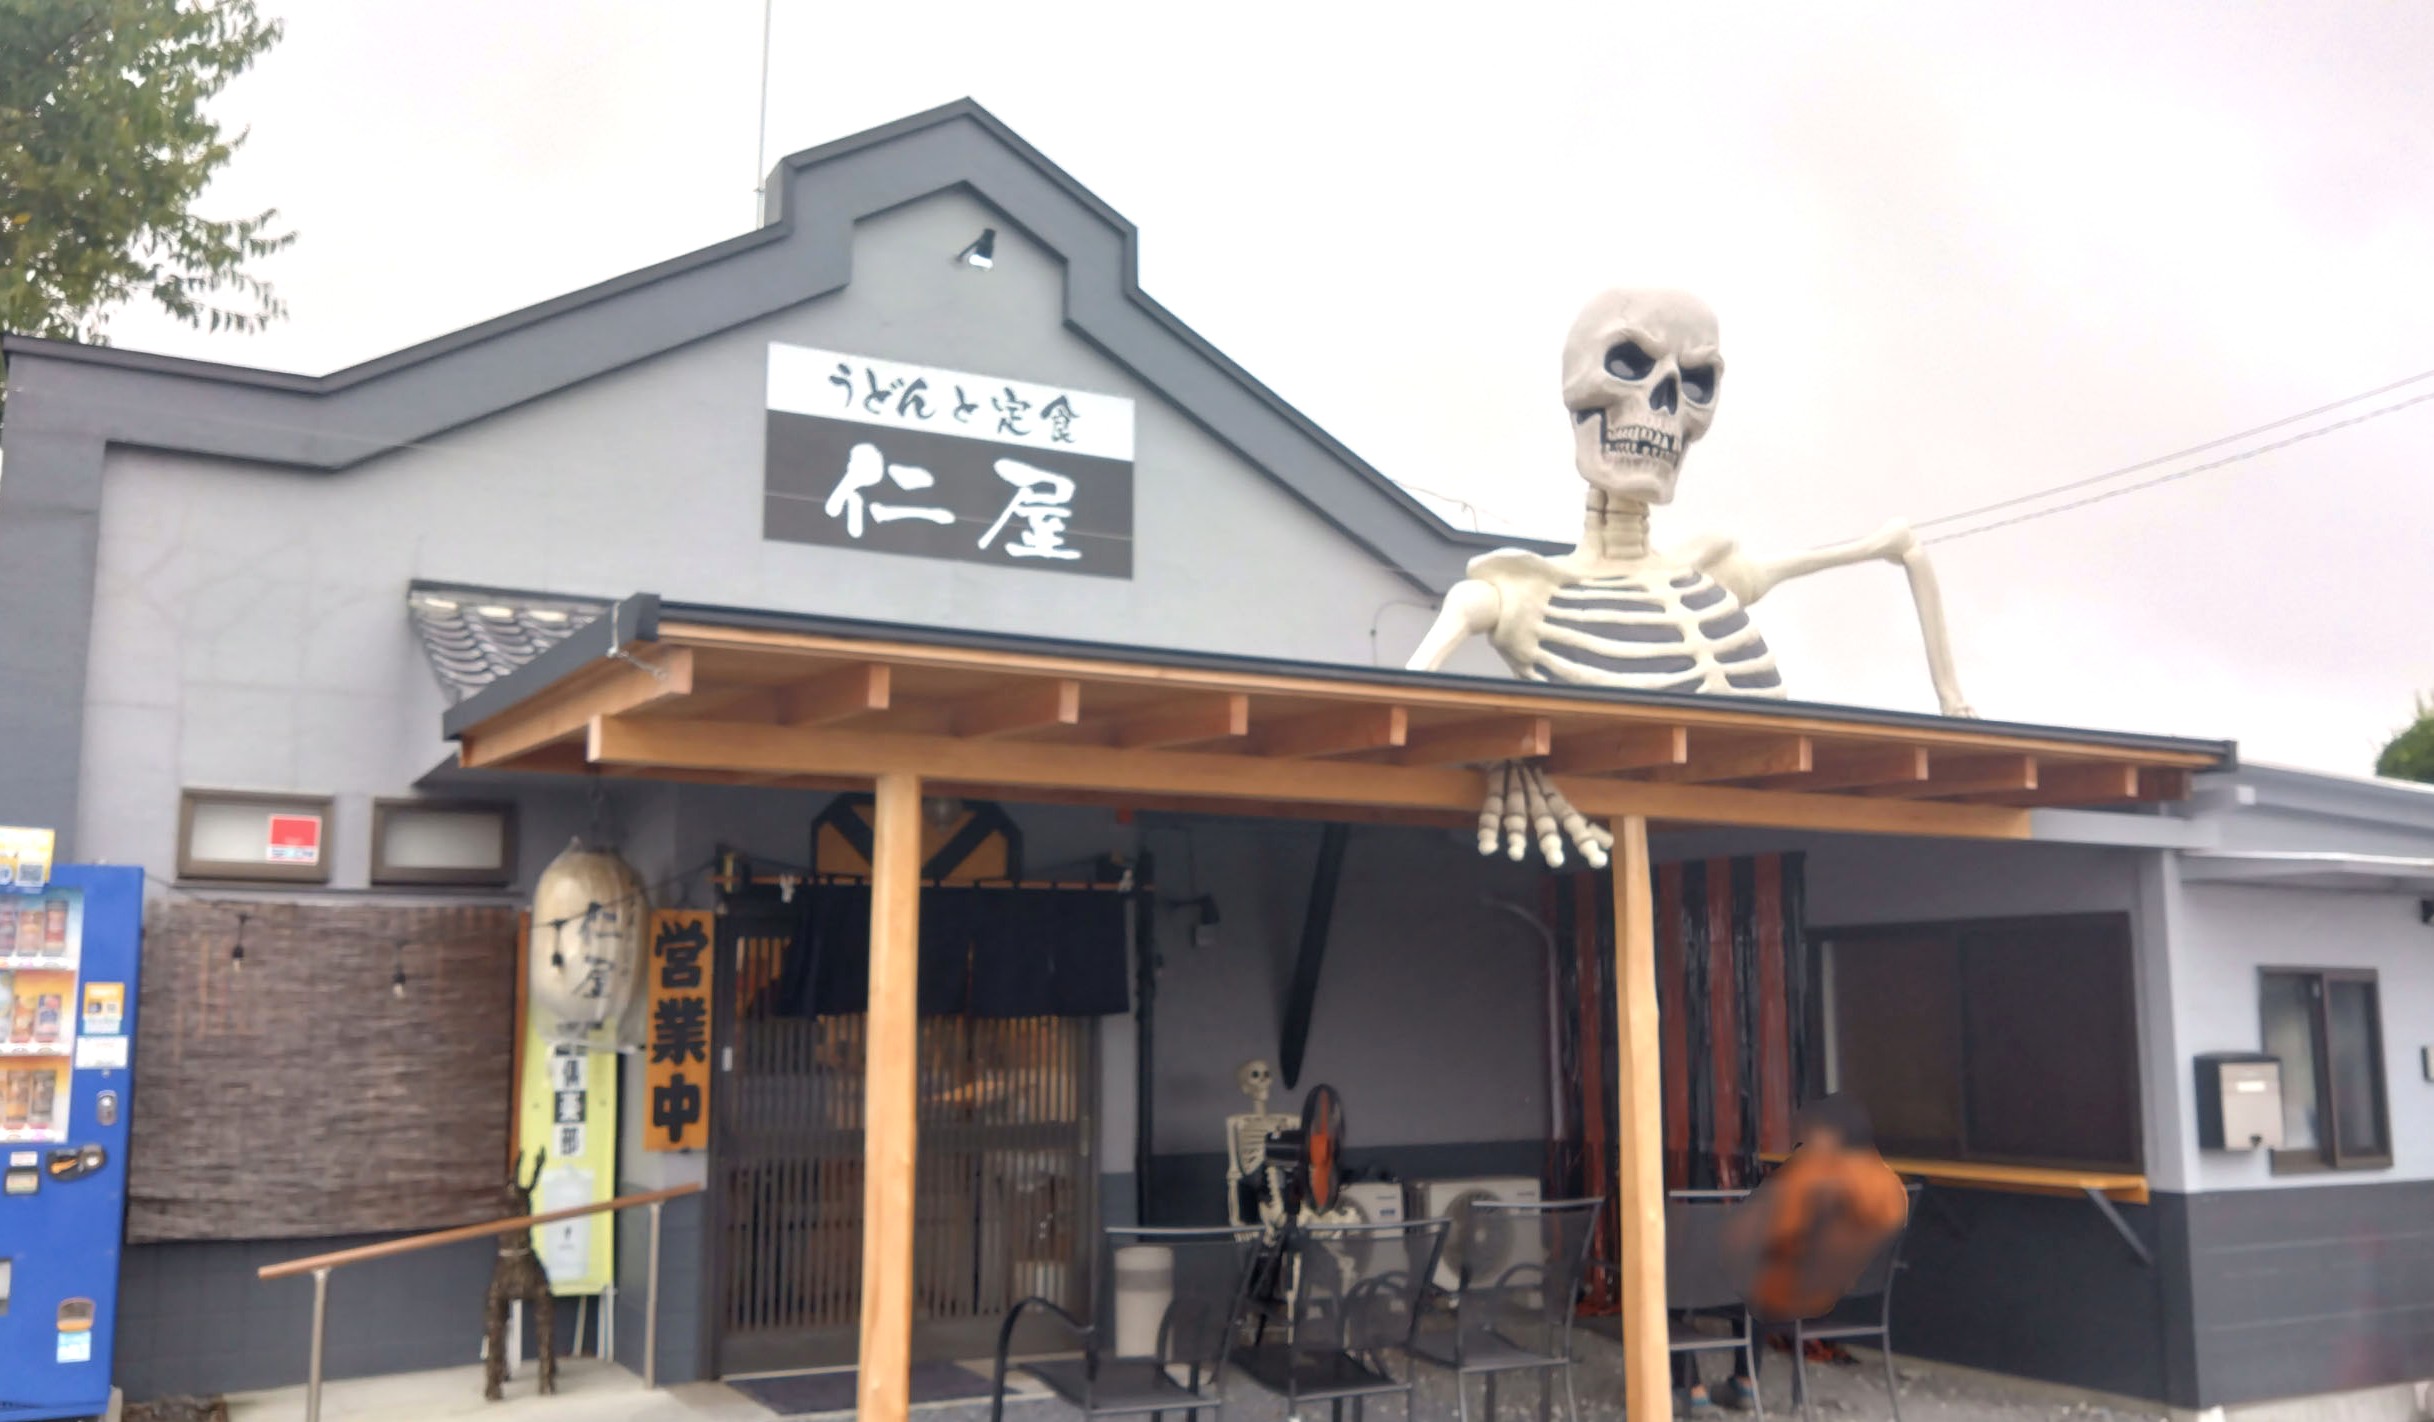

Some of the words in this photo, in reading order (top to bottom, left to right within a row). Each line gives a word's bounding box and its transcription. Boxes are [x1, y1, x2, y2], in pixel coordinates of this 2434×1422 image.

[828, 362, 1082, 444] うどんと定食
[824, 442, 1083, 560] 仁屋
[572, 901, 624, 999] 仁屋
[652, 918, 709, 1144] 営業中
